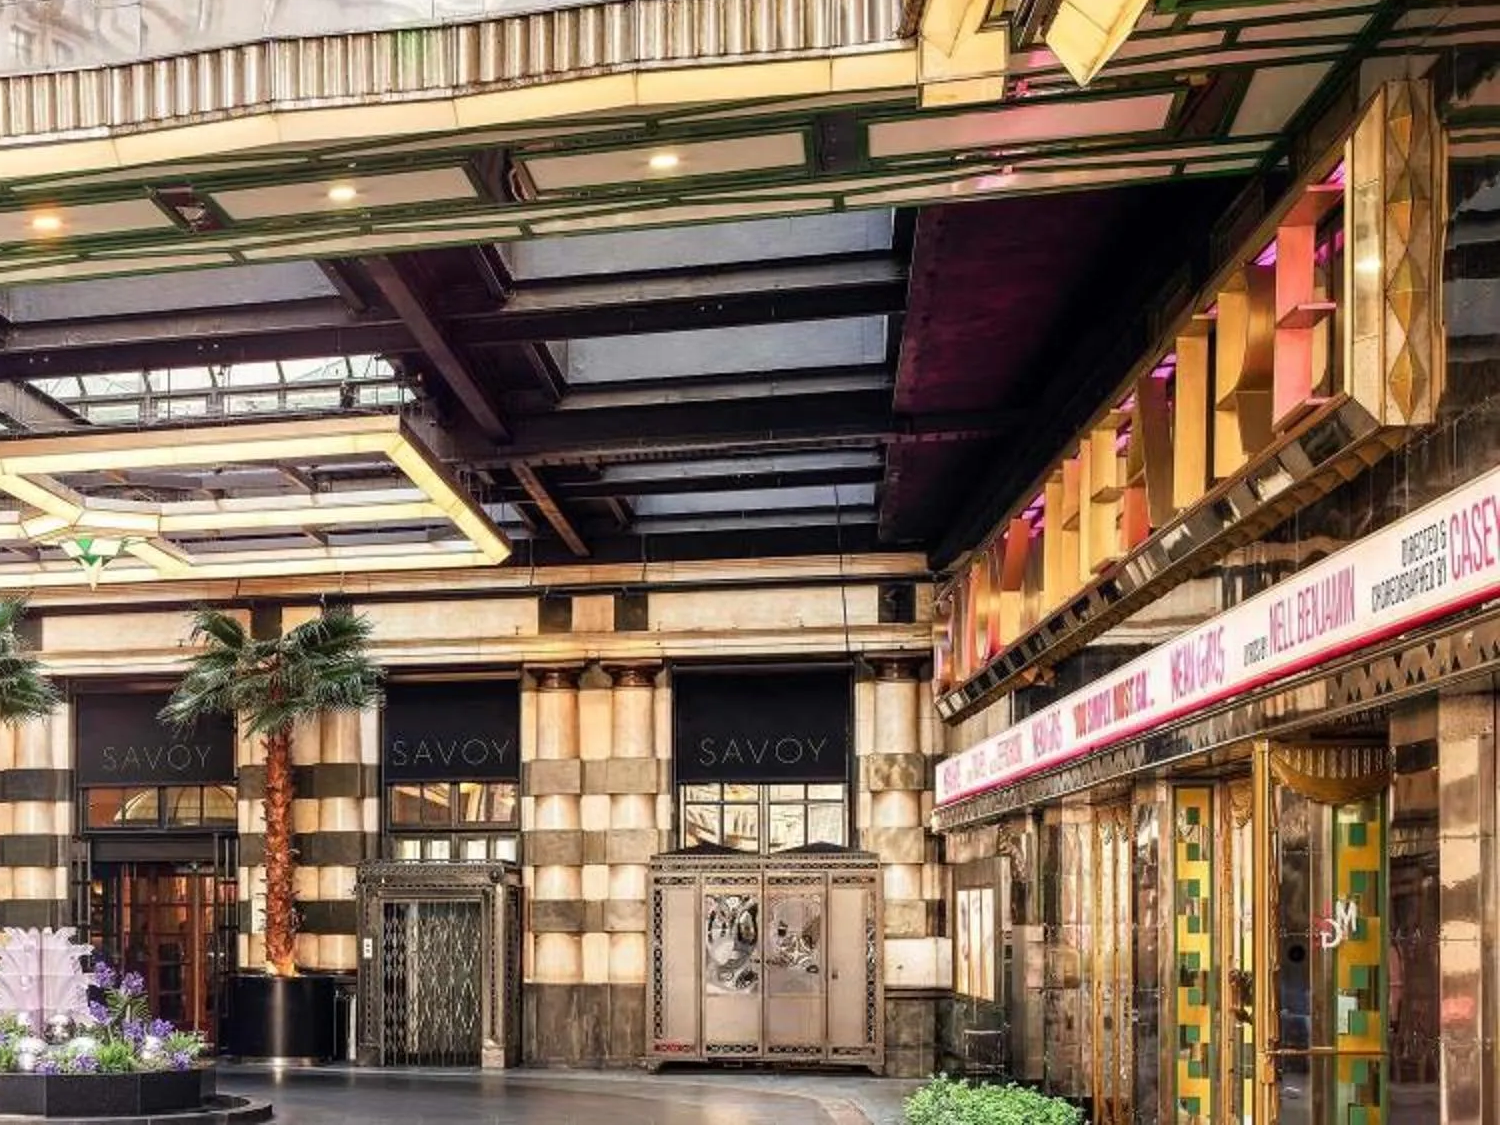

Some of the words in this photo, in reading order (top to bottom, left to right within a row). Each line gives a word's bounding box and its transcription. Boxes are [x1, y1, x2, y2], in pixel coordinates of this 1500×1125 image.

[1269, 597, 1295, 656] NELL
[1297, 564, 1355, 644] BENJAMIN
[102, 743, 212, 771] SAVOY
[393, 738, 510, 766] SAVOY
[699, 735, 828, 766] SAVOY
